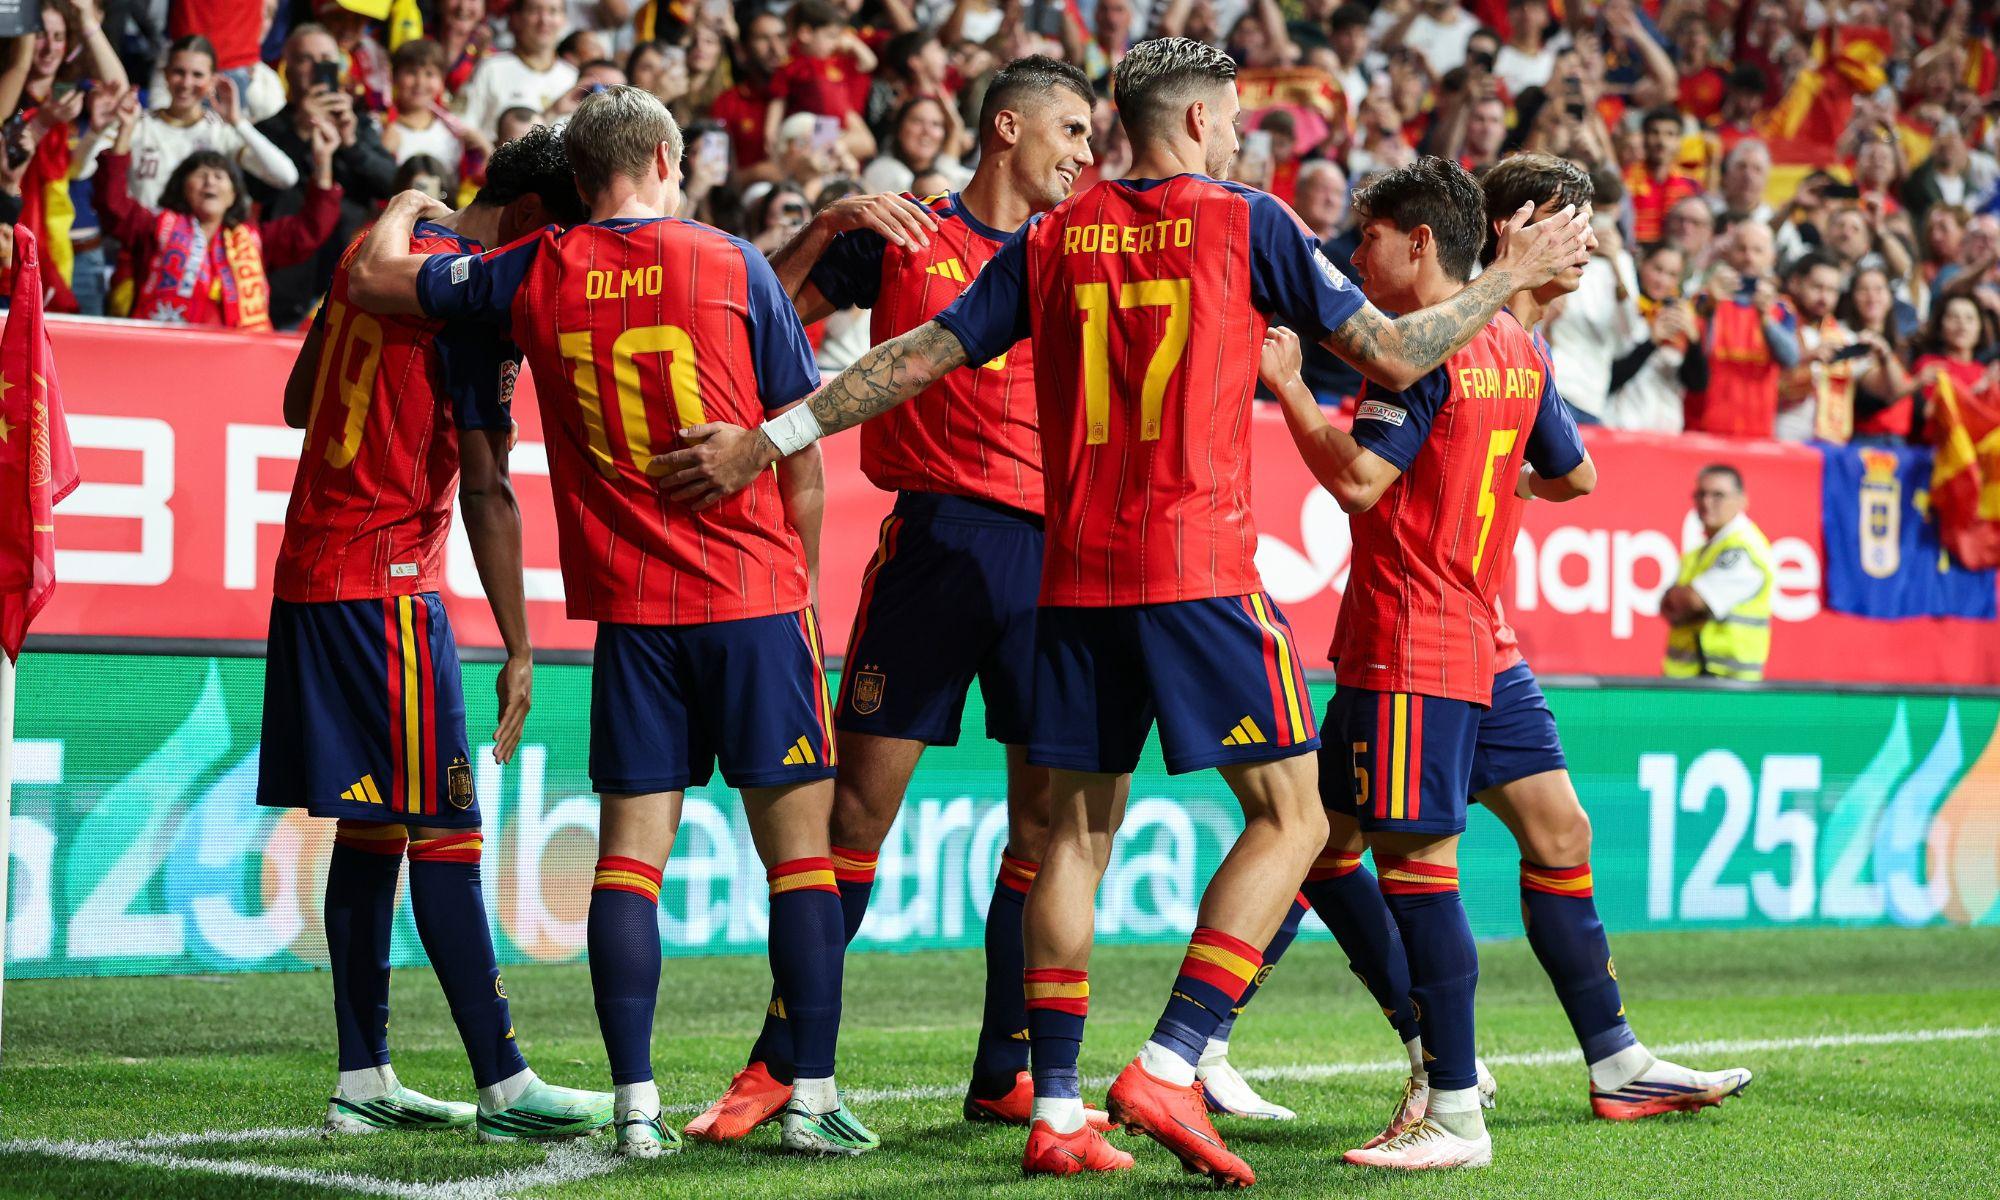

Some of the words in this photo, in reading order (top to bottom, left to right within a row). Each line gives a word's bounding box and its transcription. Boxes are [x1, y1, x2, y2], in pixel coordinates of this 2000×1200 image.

[585, 264, 663, 300] OLMO
[1065, 218, 1192, 255] ROBERTO
[303, 299, 384, 469] 19
[559, 325, 709, 479] 10
[1075, 278, 1191, 445] 17
[1458, 367, 1501, 399] FRAN
[1472, 429, 1519, 577] 5
[1512, 507, 1822, 639] ape
[1352, 741, 1369, 806] 5
[1637, 748, 1823, 923] 125
